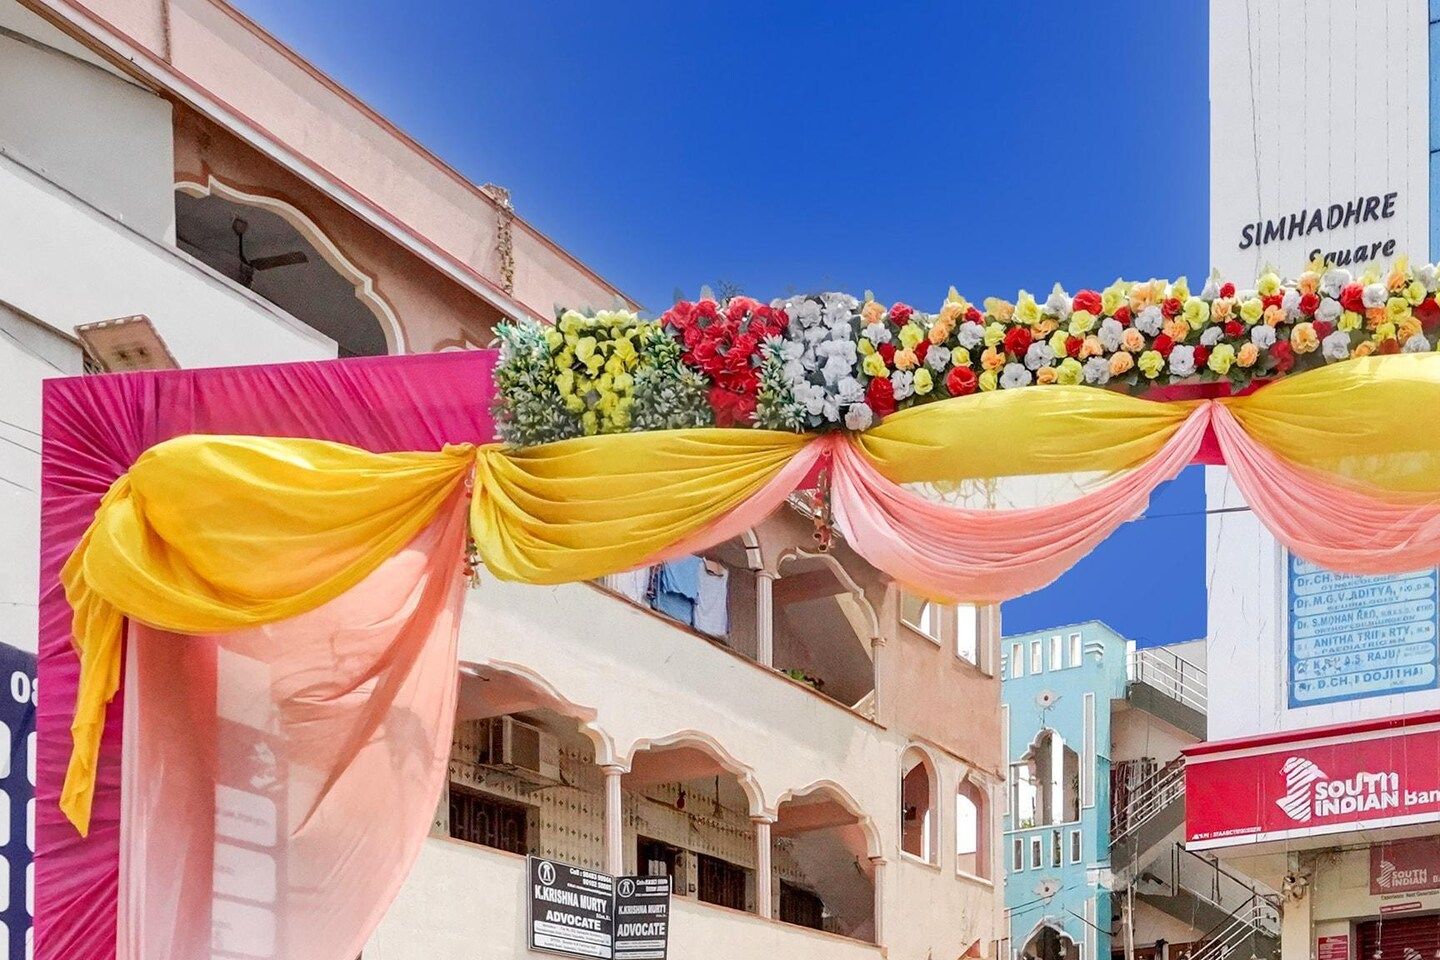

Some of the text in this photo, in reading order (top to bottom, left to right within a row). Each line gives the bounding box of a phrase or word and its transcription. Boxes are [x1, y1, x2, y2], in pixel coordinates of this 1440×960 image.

[1238, 192, 1398, 249] SIMHADHRE
[1315, 791, 1399, 816] INDIAN
[1392, 868, 1427, 879] SOUTH
[1392, 875, 1427, 886] INDIAN
[535, 884, 578, 908] K.KRISHNA
[580, 894, 607, 914] MURTY
[546, 910, 601, 931] ADVOCATE
[617, 922, 666, 937] ADVOCATE
